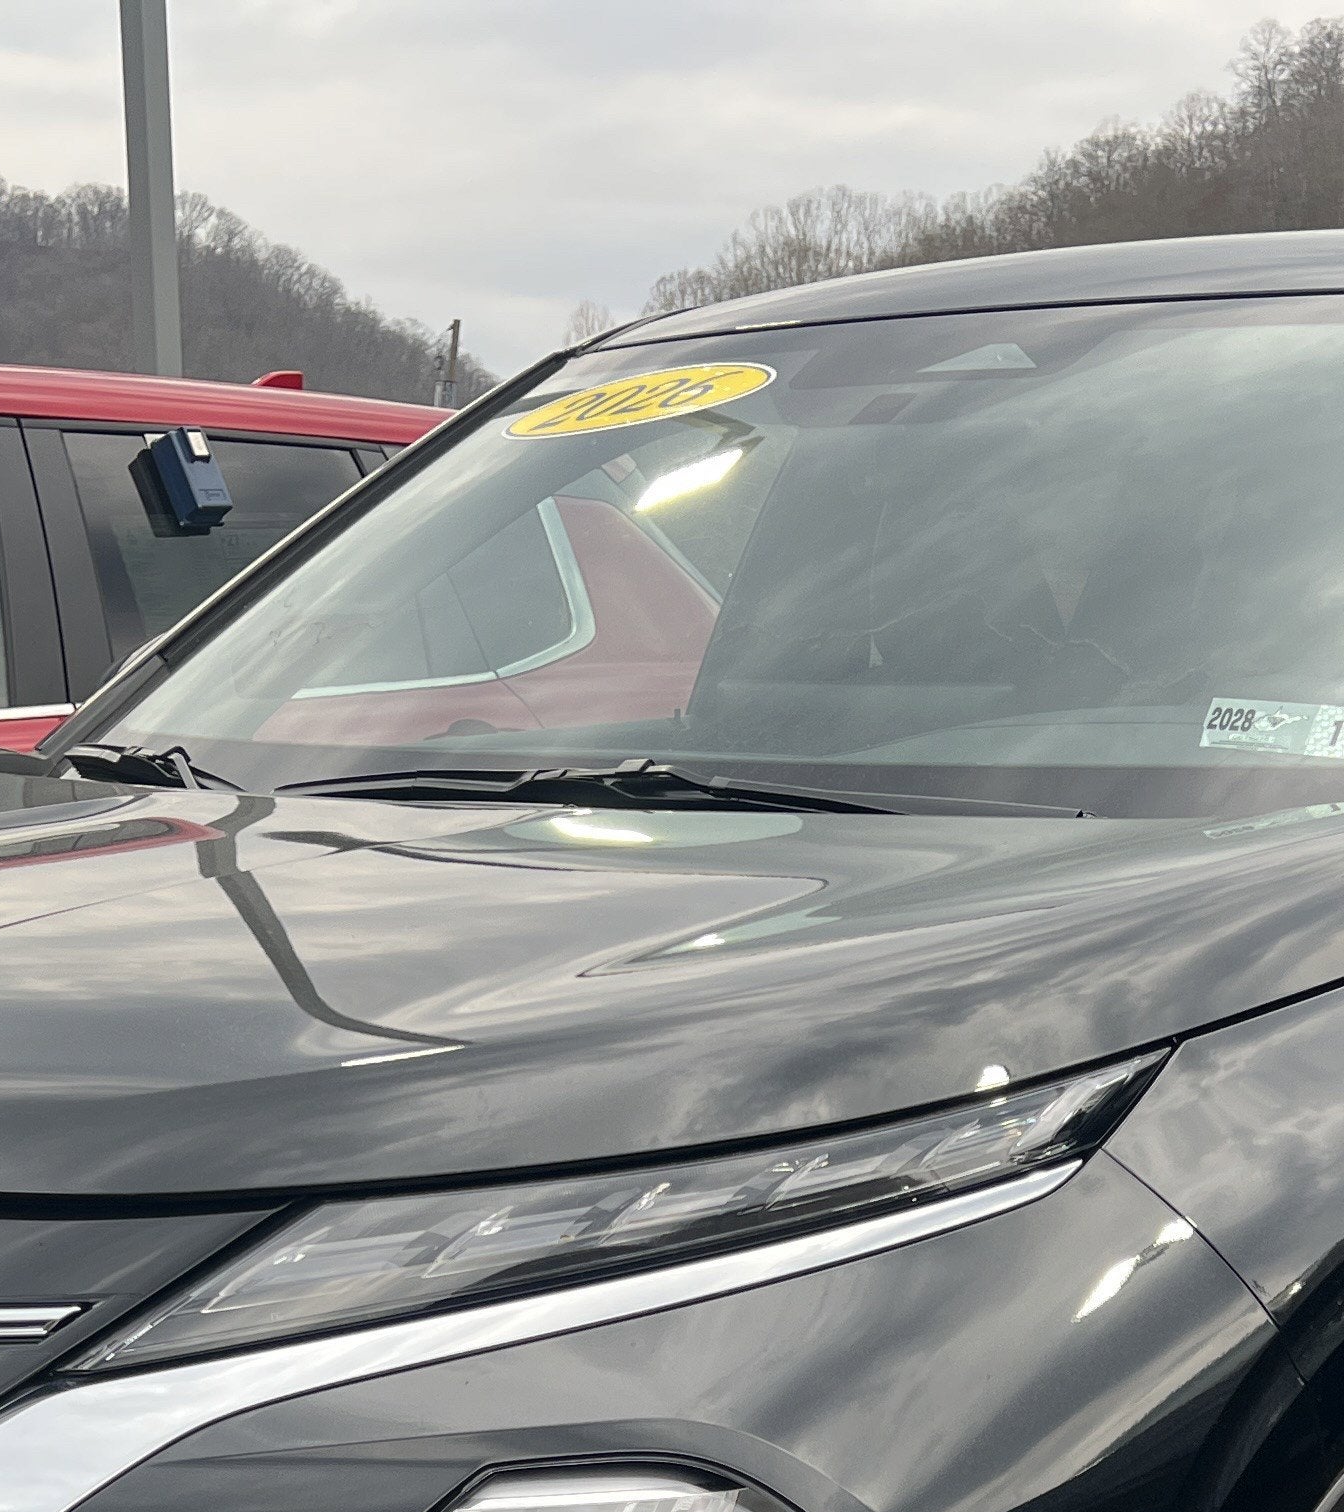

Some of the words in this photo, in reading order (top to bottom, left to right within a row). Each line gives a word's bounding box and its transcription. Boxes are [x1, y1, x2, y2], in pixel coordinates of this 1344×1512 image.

[527, 370, 744, 433] 2026
[1206, 706, 1257, 733] 2028
[1329, 720, 1344, 746] 1
